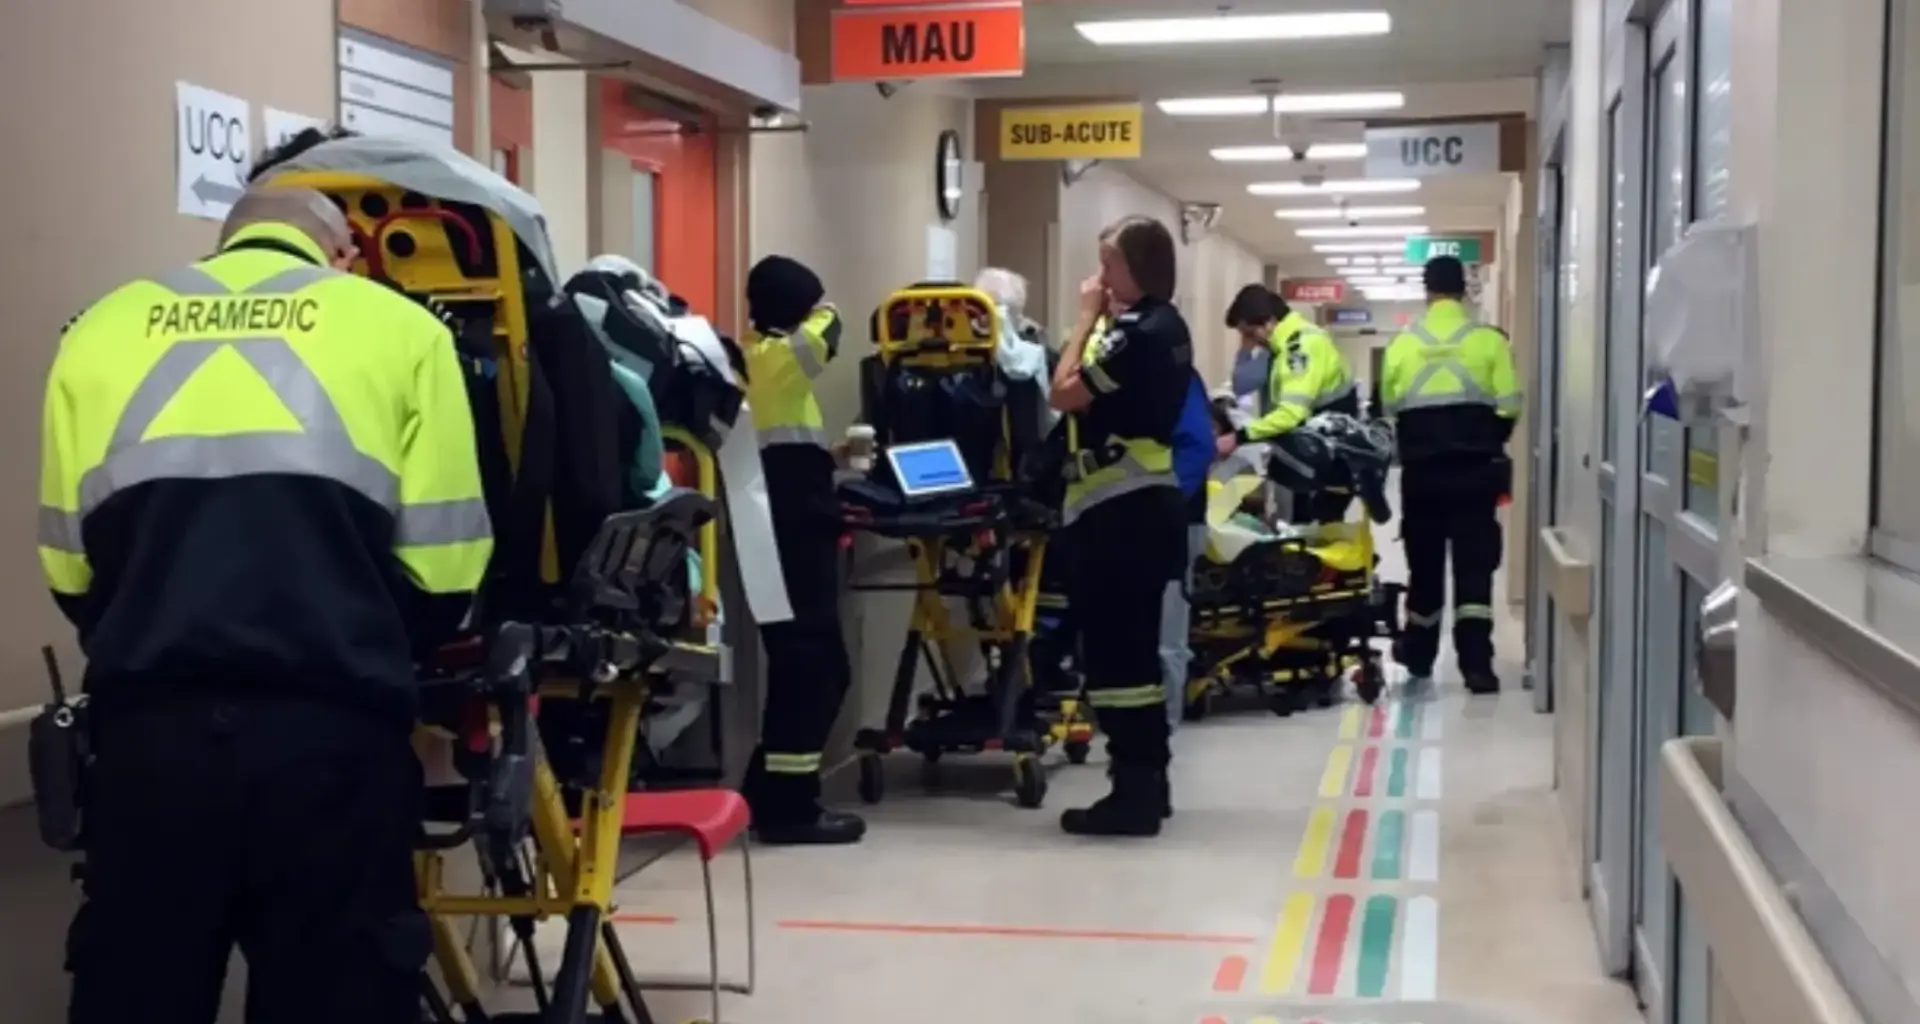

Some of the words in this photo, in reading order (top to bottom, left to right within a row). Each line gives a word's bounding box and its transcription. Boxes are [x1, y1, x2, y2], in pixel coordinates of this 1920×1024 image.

[881, 21, 976, 65] MAU
[186, 105, 245, 164] UCC
[1010, 121, 1132, 145] SUB-ACUTE
[1401, 136, 1463, 166] UCC
[146, 298, 319, 338] PARAMEDIC
